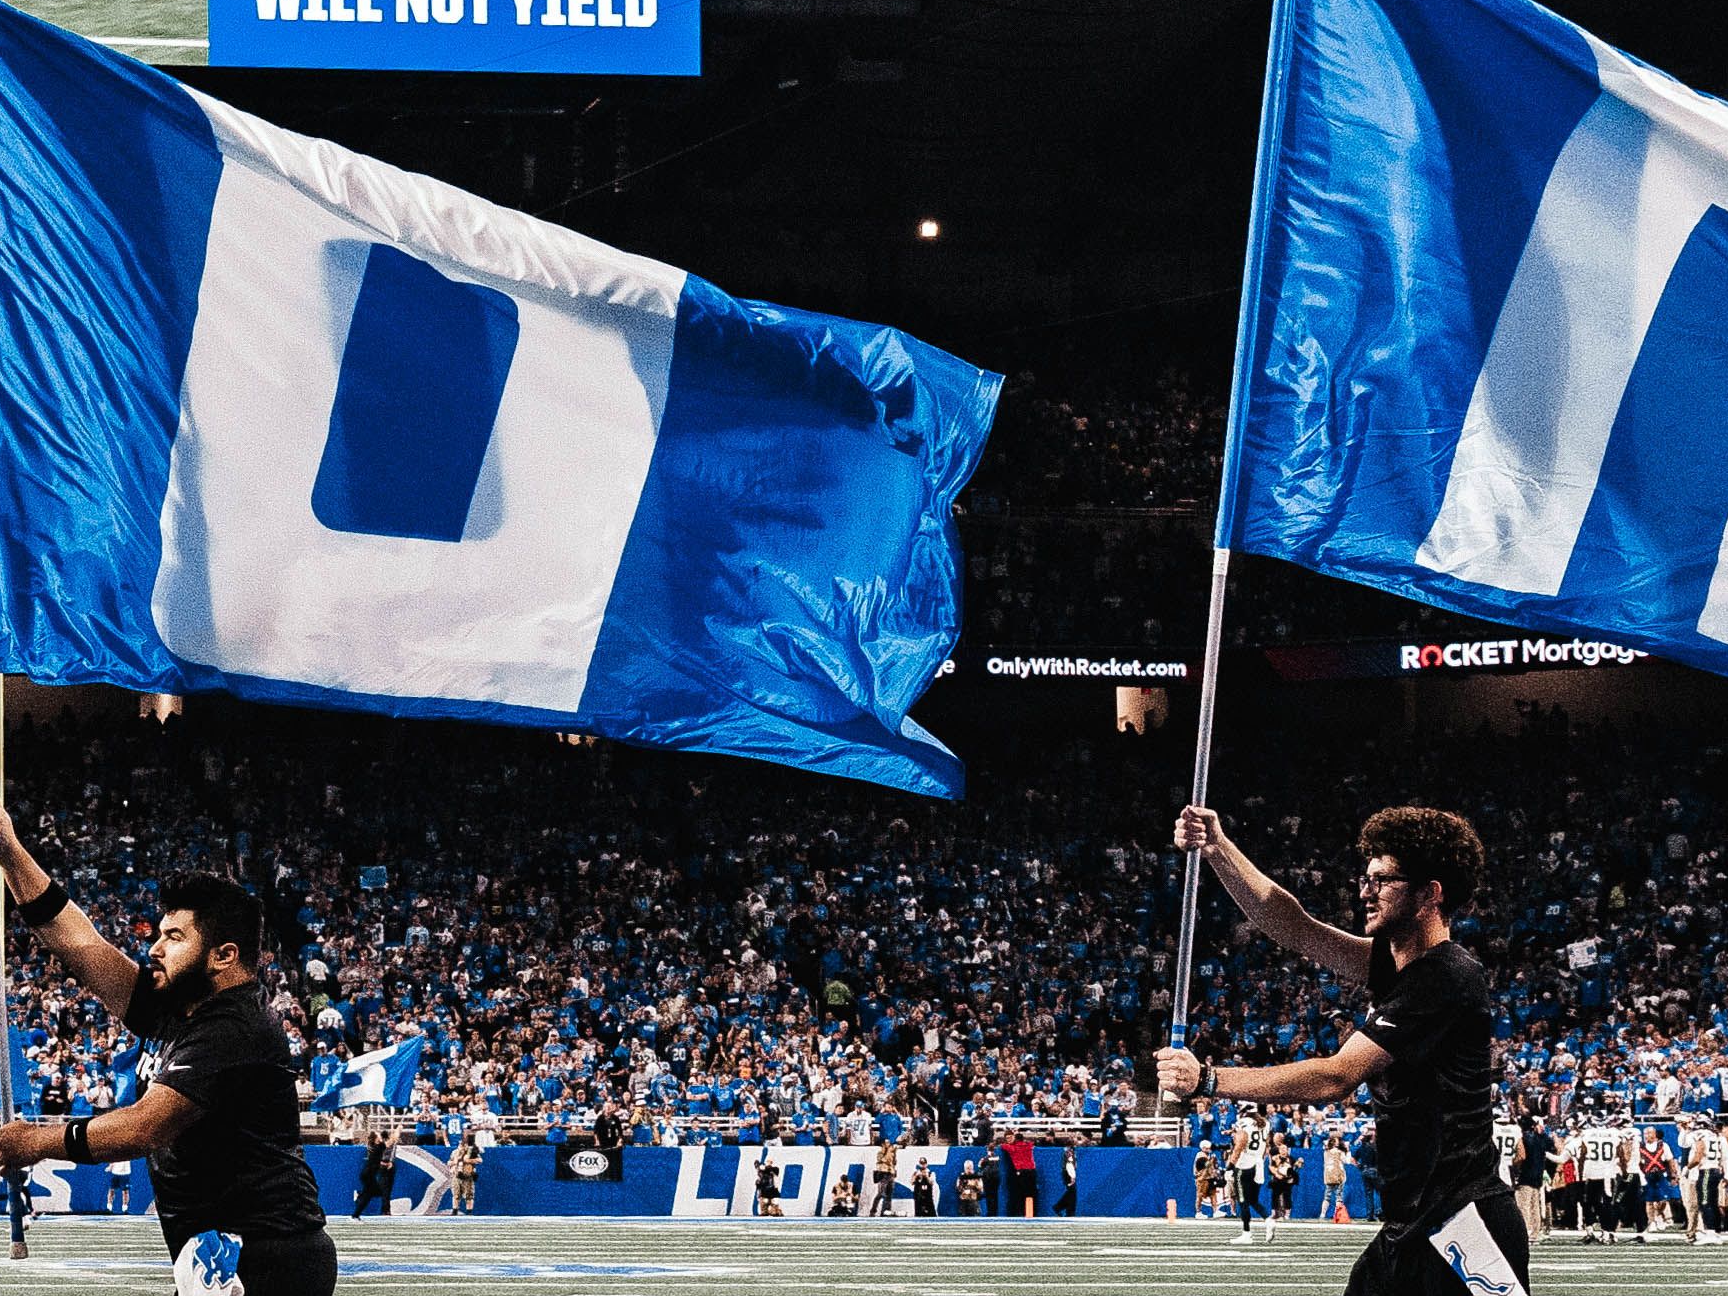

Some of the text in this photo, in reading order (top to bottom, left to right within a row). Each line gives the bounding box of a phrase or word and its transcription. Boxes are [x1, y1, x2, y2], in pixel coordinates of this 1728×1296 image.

[1400, 639, 1519, 670] ROCKET
[986, 656, 1187, 681] OnlyWithRocket.com
[578, 1156, 599, 1166] FOX
